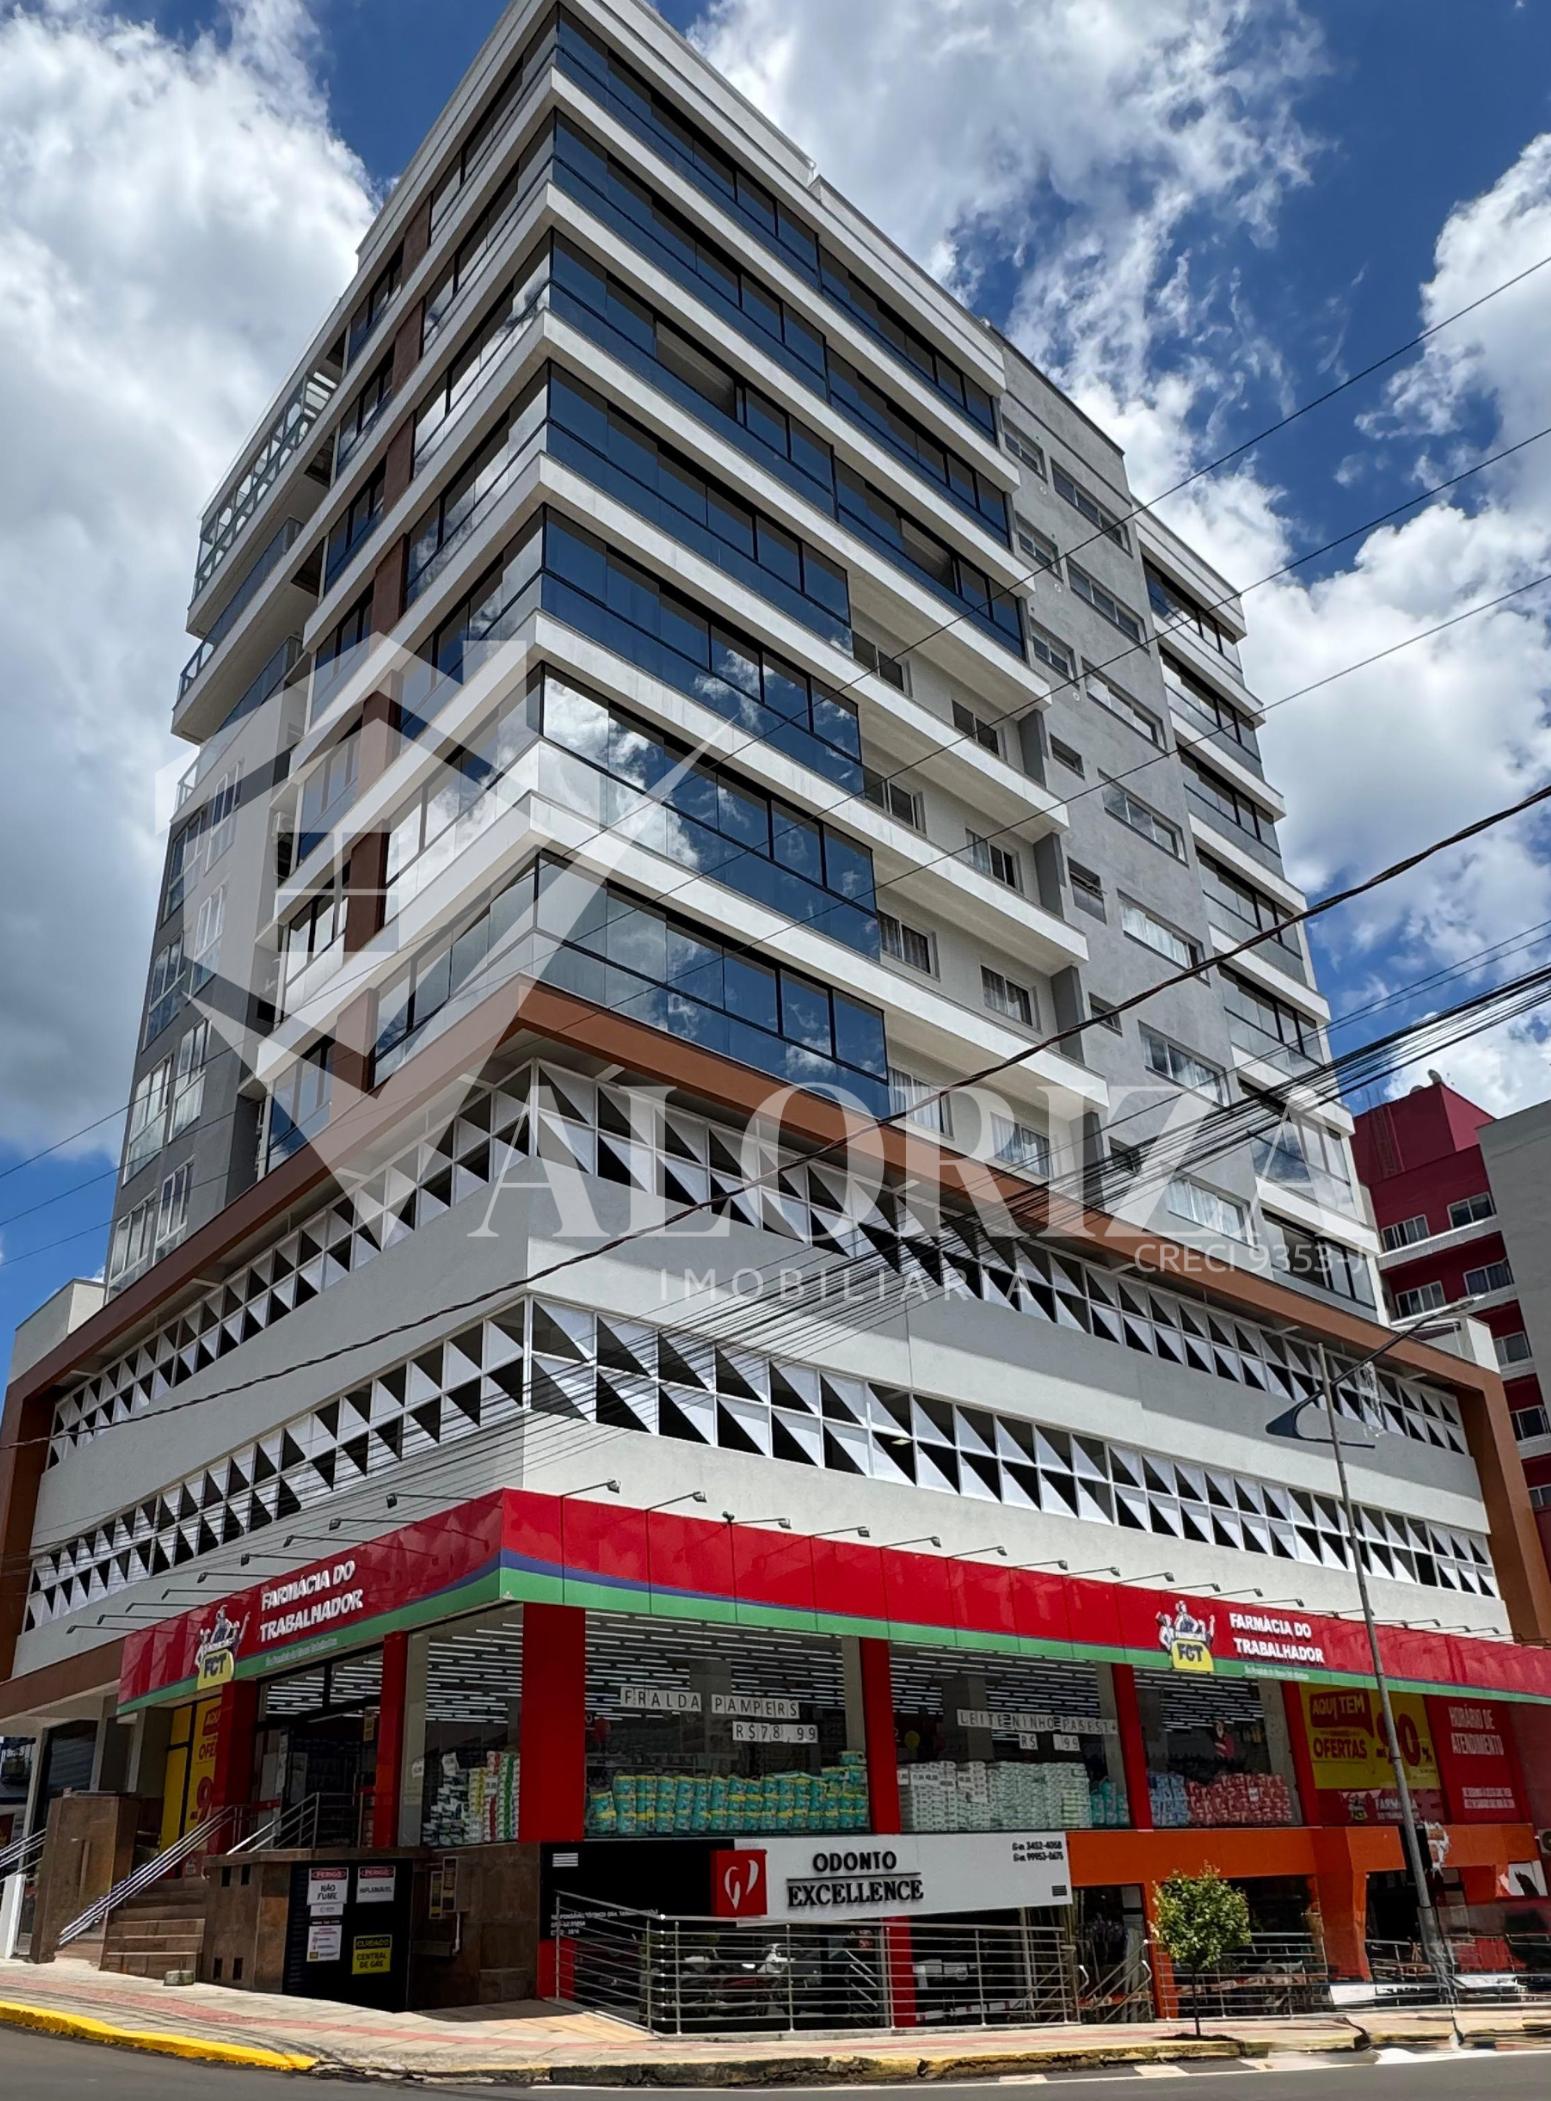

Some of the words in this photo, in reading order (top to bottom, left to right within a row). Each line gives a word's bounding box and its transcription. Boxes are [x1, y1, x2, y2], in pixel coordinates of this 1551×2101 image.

[333, 1560, 356, 1586] DO
[260, 1588, 364, 1643] TRABALHADOR
[1229, 1612, 1293, 1636] FARMÁCIA
[1294, 1622, 1312, 1639] DO
[1232, 1637, 1325, 1664] TRABALHADOR
[624, 1689, 700, 1710] FRALDA
[715, 1696, 798, 1717] PAMPERS
[1339, 1693, 1366, 1714] TEM
[1312, 1736, 1368, 1760] OFERTAS
[812, 1850, 898, 1873] ODONTO
[786, 1879, 924, 1908] EXCELLENCE
